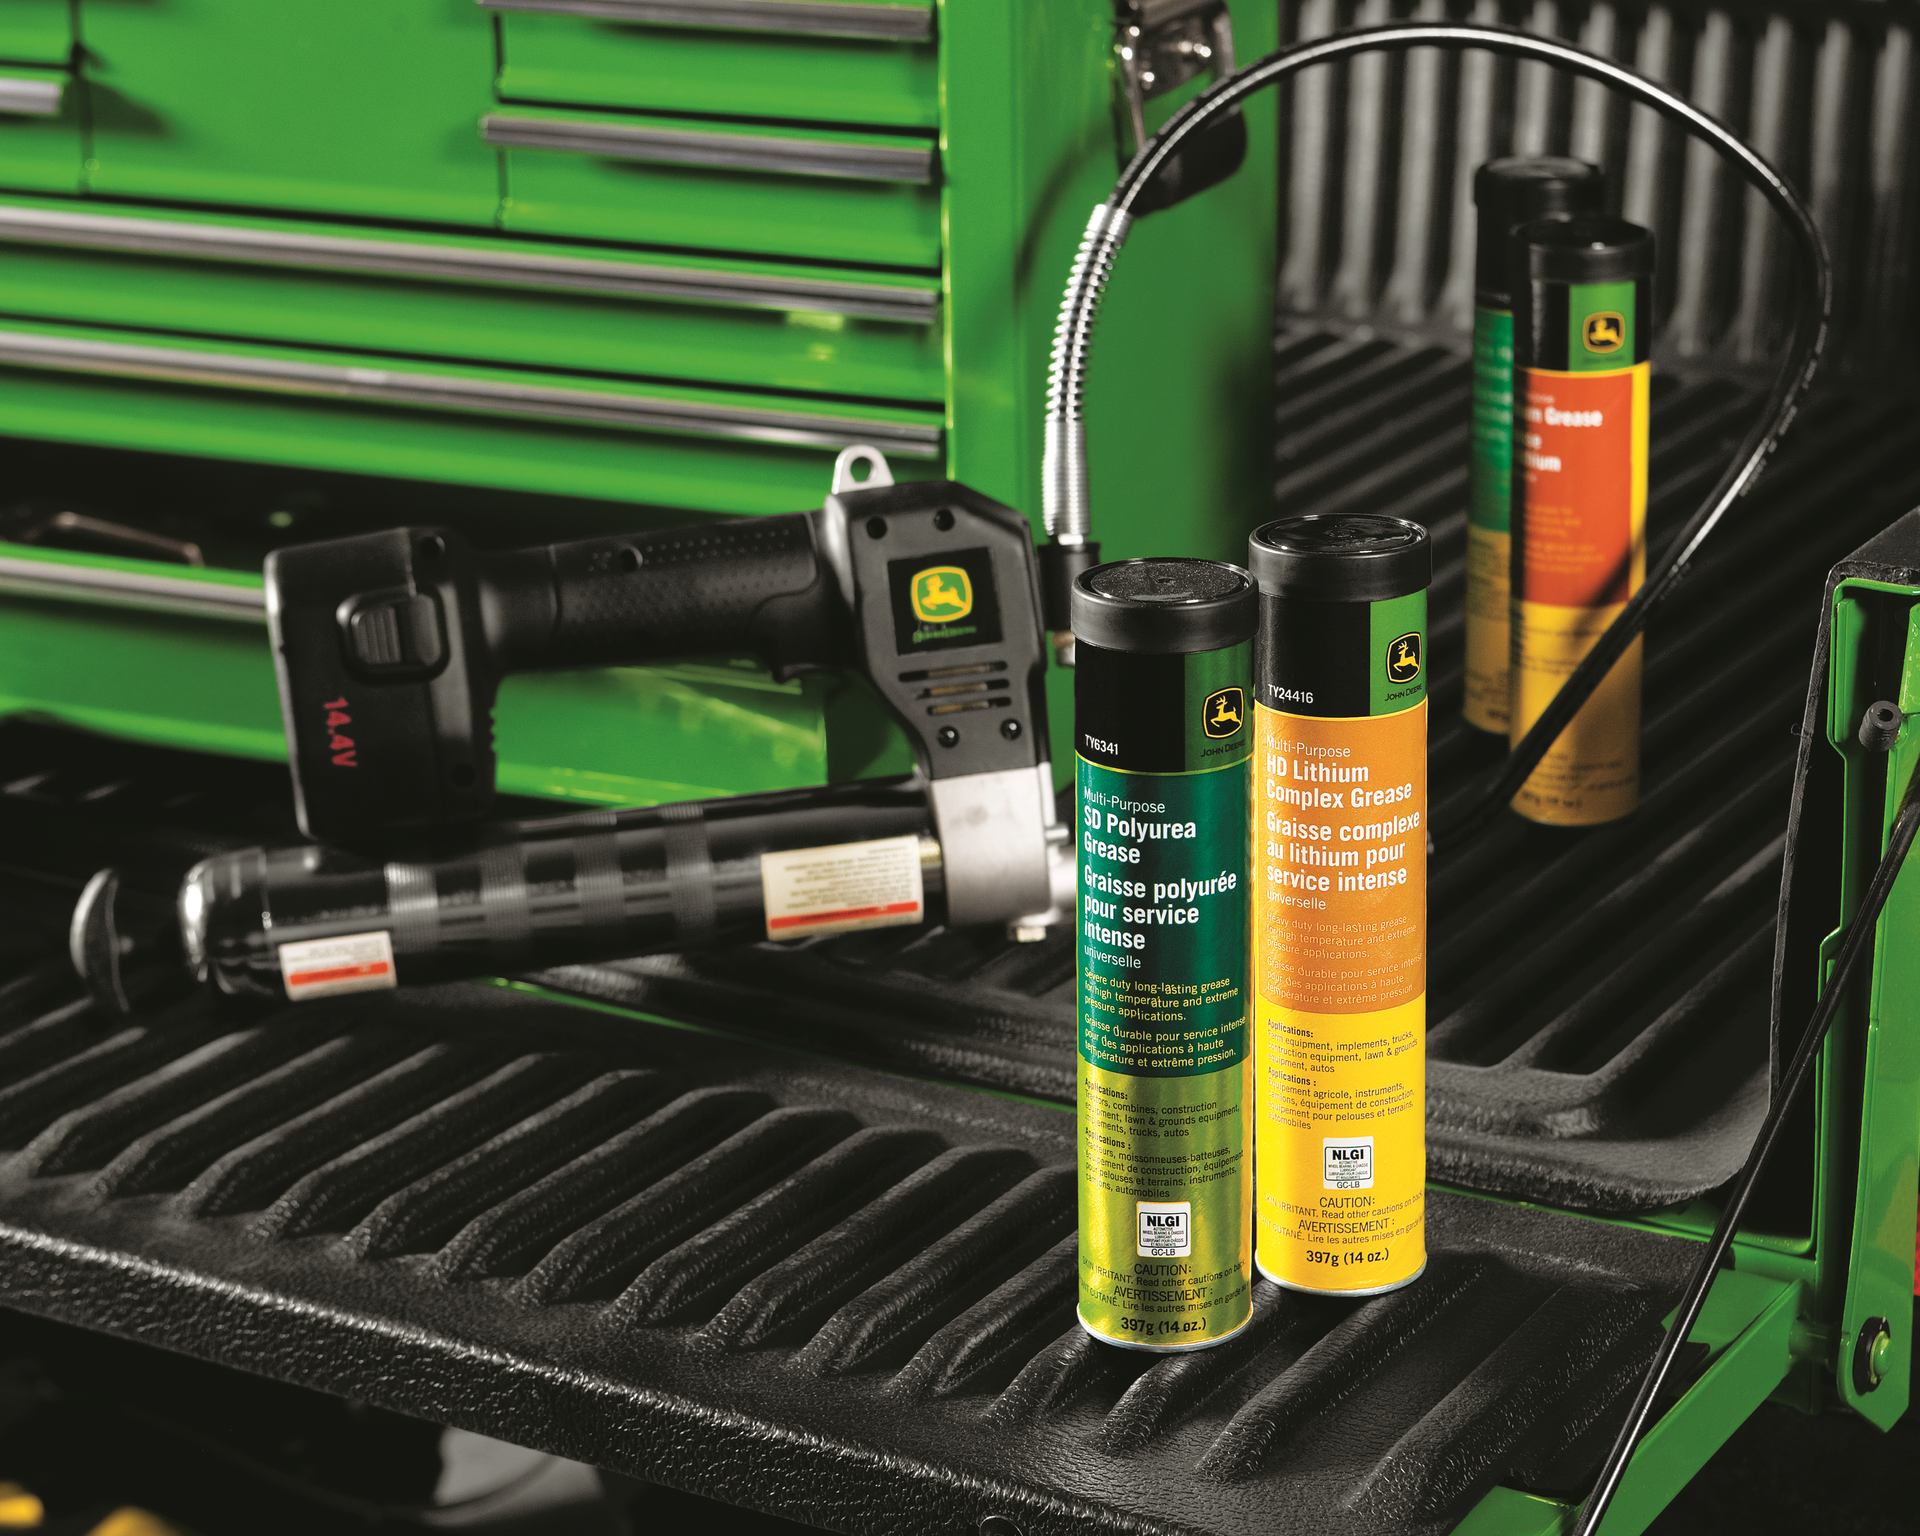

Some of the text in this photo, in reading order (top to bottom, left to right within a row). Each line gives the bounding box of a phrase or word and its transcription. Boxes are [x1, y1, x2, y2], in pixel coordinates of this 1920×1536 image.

[1268, 684, 1313, 704] TY24416
[1384, 683, 1422, 701] JOHN DEERE
[324, 697, 358, 767] 14.4V
[1085, 734, 1118, 755] TY6341
[1201, 739, 1245, 757] JOHN DEERE
[1266, 735, 1351, 759] Multi-Purpose
[1267, 753, 1369, 783] HD Lithium
[1084, 786, 1165, 814] Multi-Purpose
[1267, 779, 1412, 810] Complex Grease
[1084, 805, 1196, 842] SD Polyurea
[1267, 811, 1420, 842] Graisse complexe
[1084, 831, 1141, 864] Grease
[1267, 841, 1405, 869] au lithium pour
[1084, 865, 1237, 903] Graisse polyurée
[1267, 866, 1407, 891] service intense
[1084, 894, 1199, 924] pour service
[1267, 890, 1326, 910] universelle
[1085, 916, 1145, 949] intense
[1266, 911, 1408, 934] Heavy duty long-lasting grease
[1267, 923, 1417, 947] for high temperature and extreme
[1084, 945, 1141, 968] universelle
[1267, 938, 1370, 960] pressure applications.
[1267, 956, 1295, 973] Graisse
[1298, 965, 1337, 979] durable
[1341, 970, 1364, 980] pour
[1367, 963, 1398, 977] service
[1085, 967, 1230, 995] Severe duty long-lasting grease
[1268, 970, 1404, 993] pour des applications haute
[1085, 980, 1238, 1008] for high temperature and extreme
[1323, 995, 1332, 1004] et
[1337, 992, 1377, 1005] extrême
[1380, 984, 1413, 1002] pression
[1085, 995, 1186, 1021] pressure applications.
[1085, 1013, 1246, 1043] Graisse durable pour service intense
[1268, 1018, 1313, 1038] Applications:
[1085, 1028, 1224, 1054] pour des applications haute
[1286, 1031, 1413, 1052] equipment, implements, trucks,
[1310, 1053, 1362, 1063] equipment,
[1365, 1052, 1383, 1060] lawn
[1394, 1038, 1417, 1056] grounds
[1138, 1057, 1148, 1067] et
[1152, 1057, 1194, 1067] extrême
[1198, 1049, 1236, 1067] pression.
[1310, 1063, 1335, 1072] autos
[1268, 1066, 1310, 1086] Applications
[1314, 1083, 1404, 1100] agricole, instruments,
[1113, 1102, 1217, 1115] combines, construction
[1125, 1104, 1240, 1127] lawn grounds equipment,
[1300, 1099, 1353, 1111] équipement
[1356, 1100, 1367, 1109] de
[1313, 1113, 1332, 1121] pour
[1336, 1112, 1375, 1122] pelouses
[1377, 1109, 1385, 1118] et
[1129, 1127, 1189, 1138] trucks, autos
[1119, 1147, 1230, 1164] moissonneuses-batteuses,
[1332, 1149, 1364, 1160] NLGI
[1100, 1167, 1237, 1186] pelouses et terrains, instruments,
[1127, 1164, 1201, 1175] de construction,
[1116, 1185, 1170, 1198] automobiles
[1337, 1181, 1360, 1189] GC-LB
[1279, 1201, 1403, 1219] IRRITANT. Read other cautions
[1319, 1196, 1375, 1209] CAUTION:
[1147, 1216, 1179, 1226] NLGI
[1298, 1218, 1390, 1233] AVERTISSEMENT
[1308, 1234, 1324, 1243] Lire
[1327, 1235, 1339, 1244] les
[1342, 1235, 1369, 1244] autres
[1372, 1231, 1394, 1241] mises
[1306, 1248, 1389, 1267] 397g (14 oz.)
[1096, 1265, 1232, 1287] IRRITANT. Read other cautions on
[1134, 1263, 1192, 1276] CAUTION:
[1114, 1286, 1207, 1302] AVERTISSEMENT
[1123, 1300, 1139, 1311] Lire
[1141, 1303, 1154, 1312] les
[1157, 1304, 1185, 1312] autres
[1188, 1301, 1212, 1311] mises
[1214, 1297, 1223, 1305] en
[1121, 1317, 1206, 1335] 397g (14 oz.)
